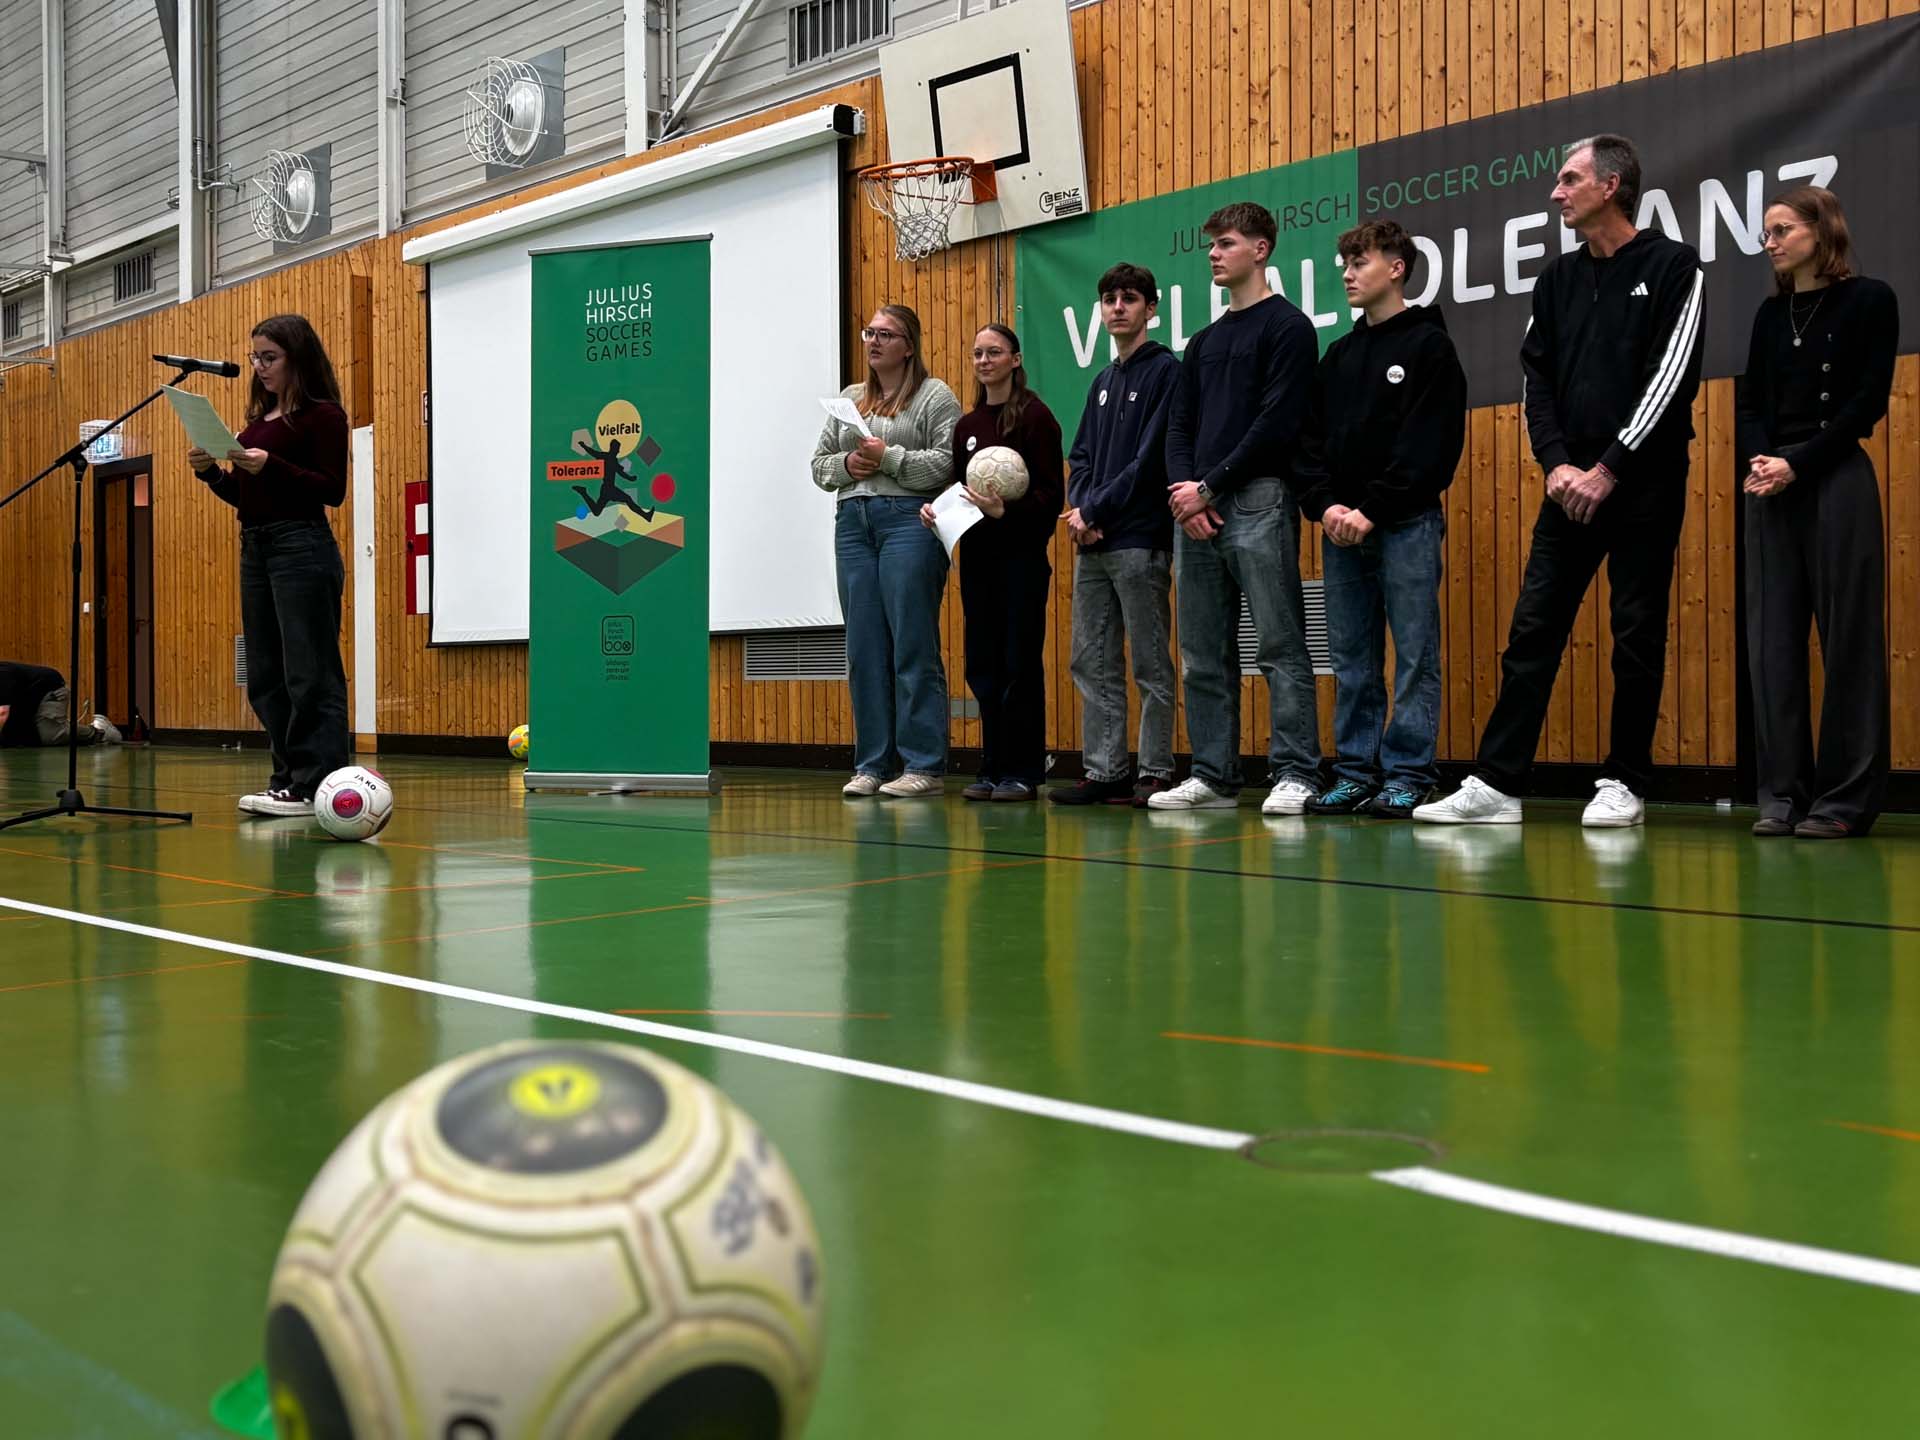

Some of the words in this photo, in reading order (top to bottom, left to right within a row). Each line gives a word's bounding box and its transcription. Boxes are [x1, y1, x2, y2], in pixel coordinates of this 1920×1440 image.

[1365, 165, 1480, 214] SOCCER
[1488, 144, 1577, 187] GAM
[585, 283, 652, 306] JULIUS
[586, 302, 652, 325] HIRSCH
[586, 322, 652, 343] SOCCER
[586, 341, 652, 361] GAMES
[598, 423, 640, 436] Vielfalt
[551, 465, 600, 477] Toleranz
